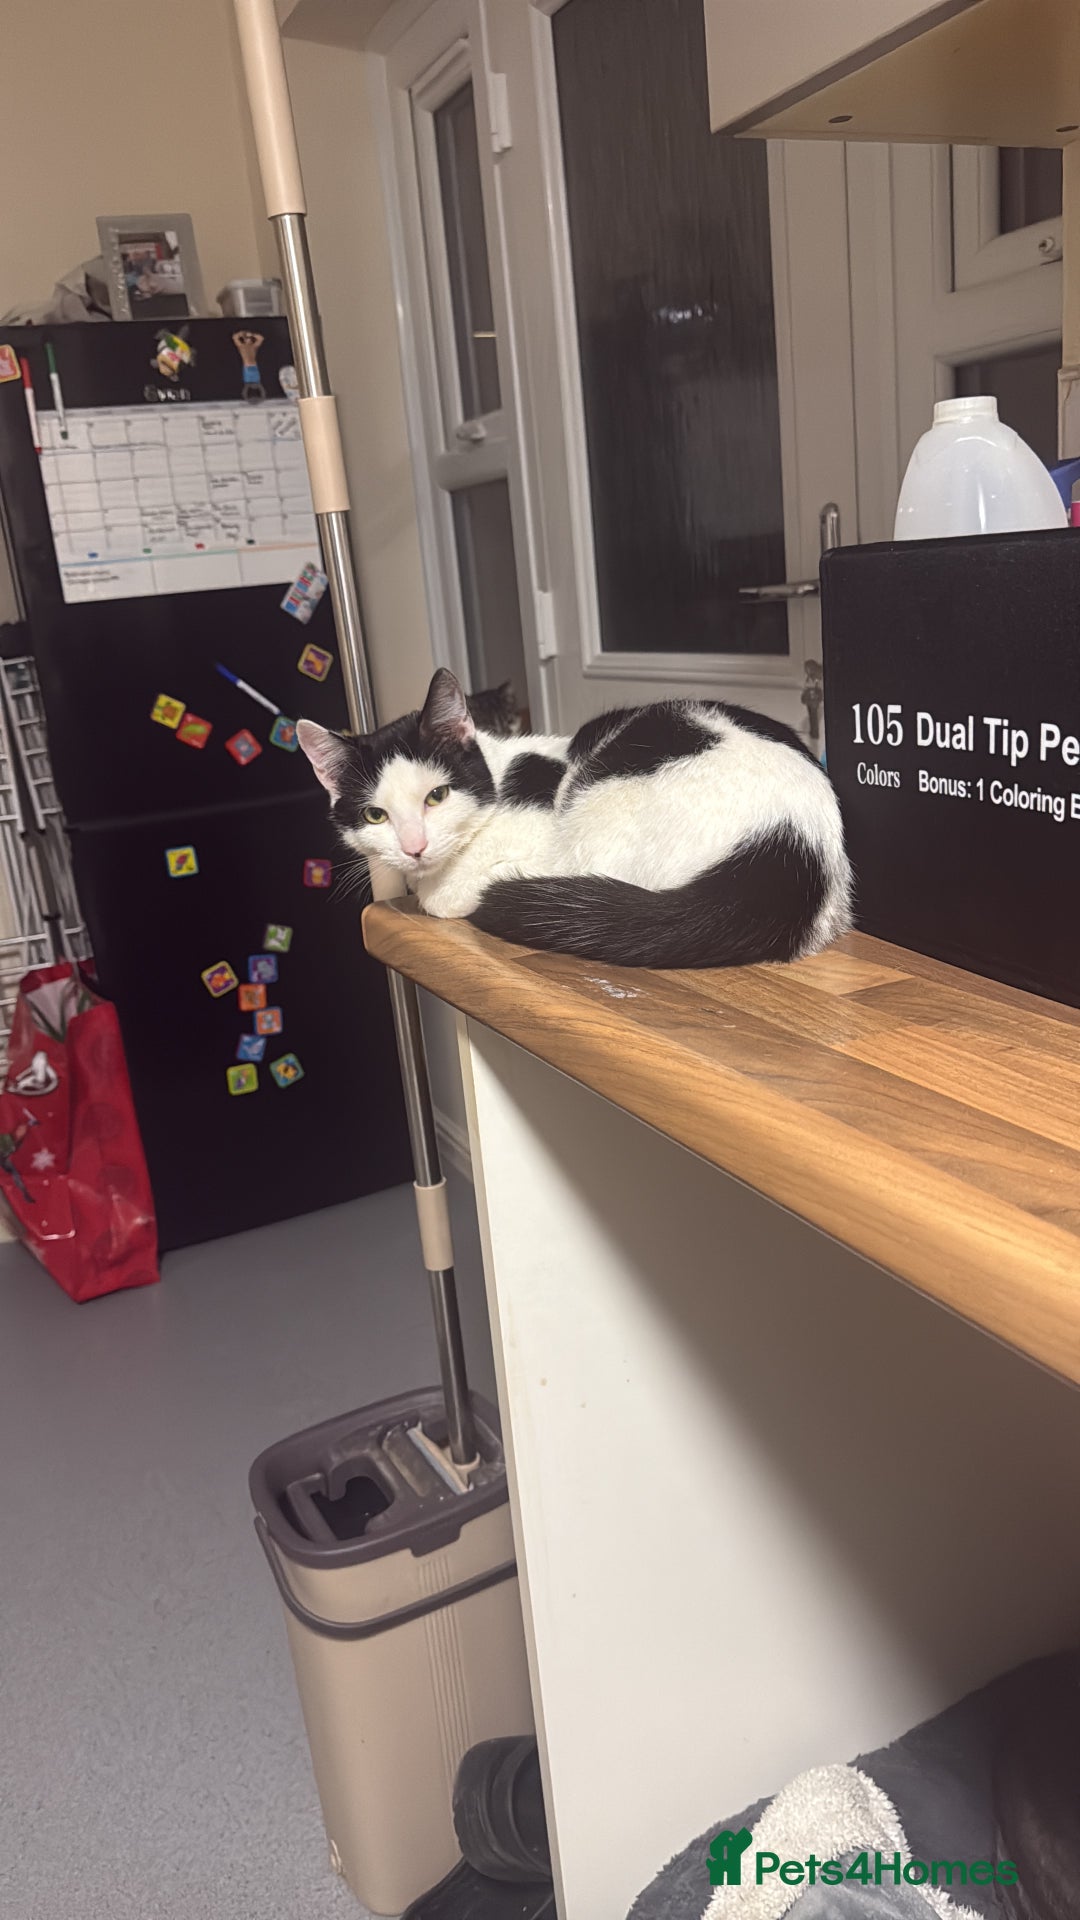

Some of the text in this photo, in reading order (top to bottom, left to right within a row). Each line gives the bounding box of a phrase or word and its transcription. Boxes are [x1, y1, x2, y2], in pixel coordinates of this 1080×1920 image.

[852, 703, 1080, 767] 105 Dual Tip Pe
[856, 761, 901, 788] Colors
[918, 769, 972, 799] Bonus:
[976, 777, 984, 801] 1
[989, 779, 1066, 823] Coloring
